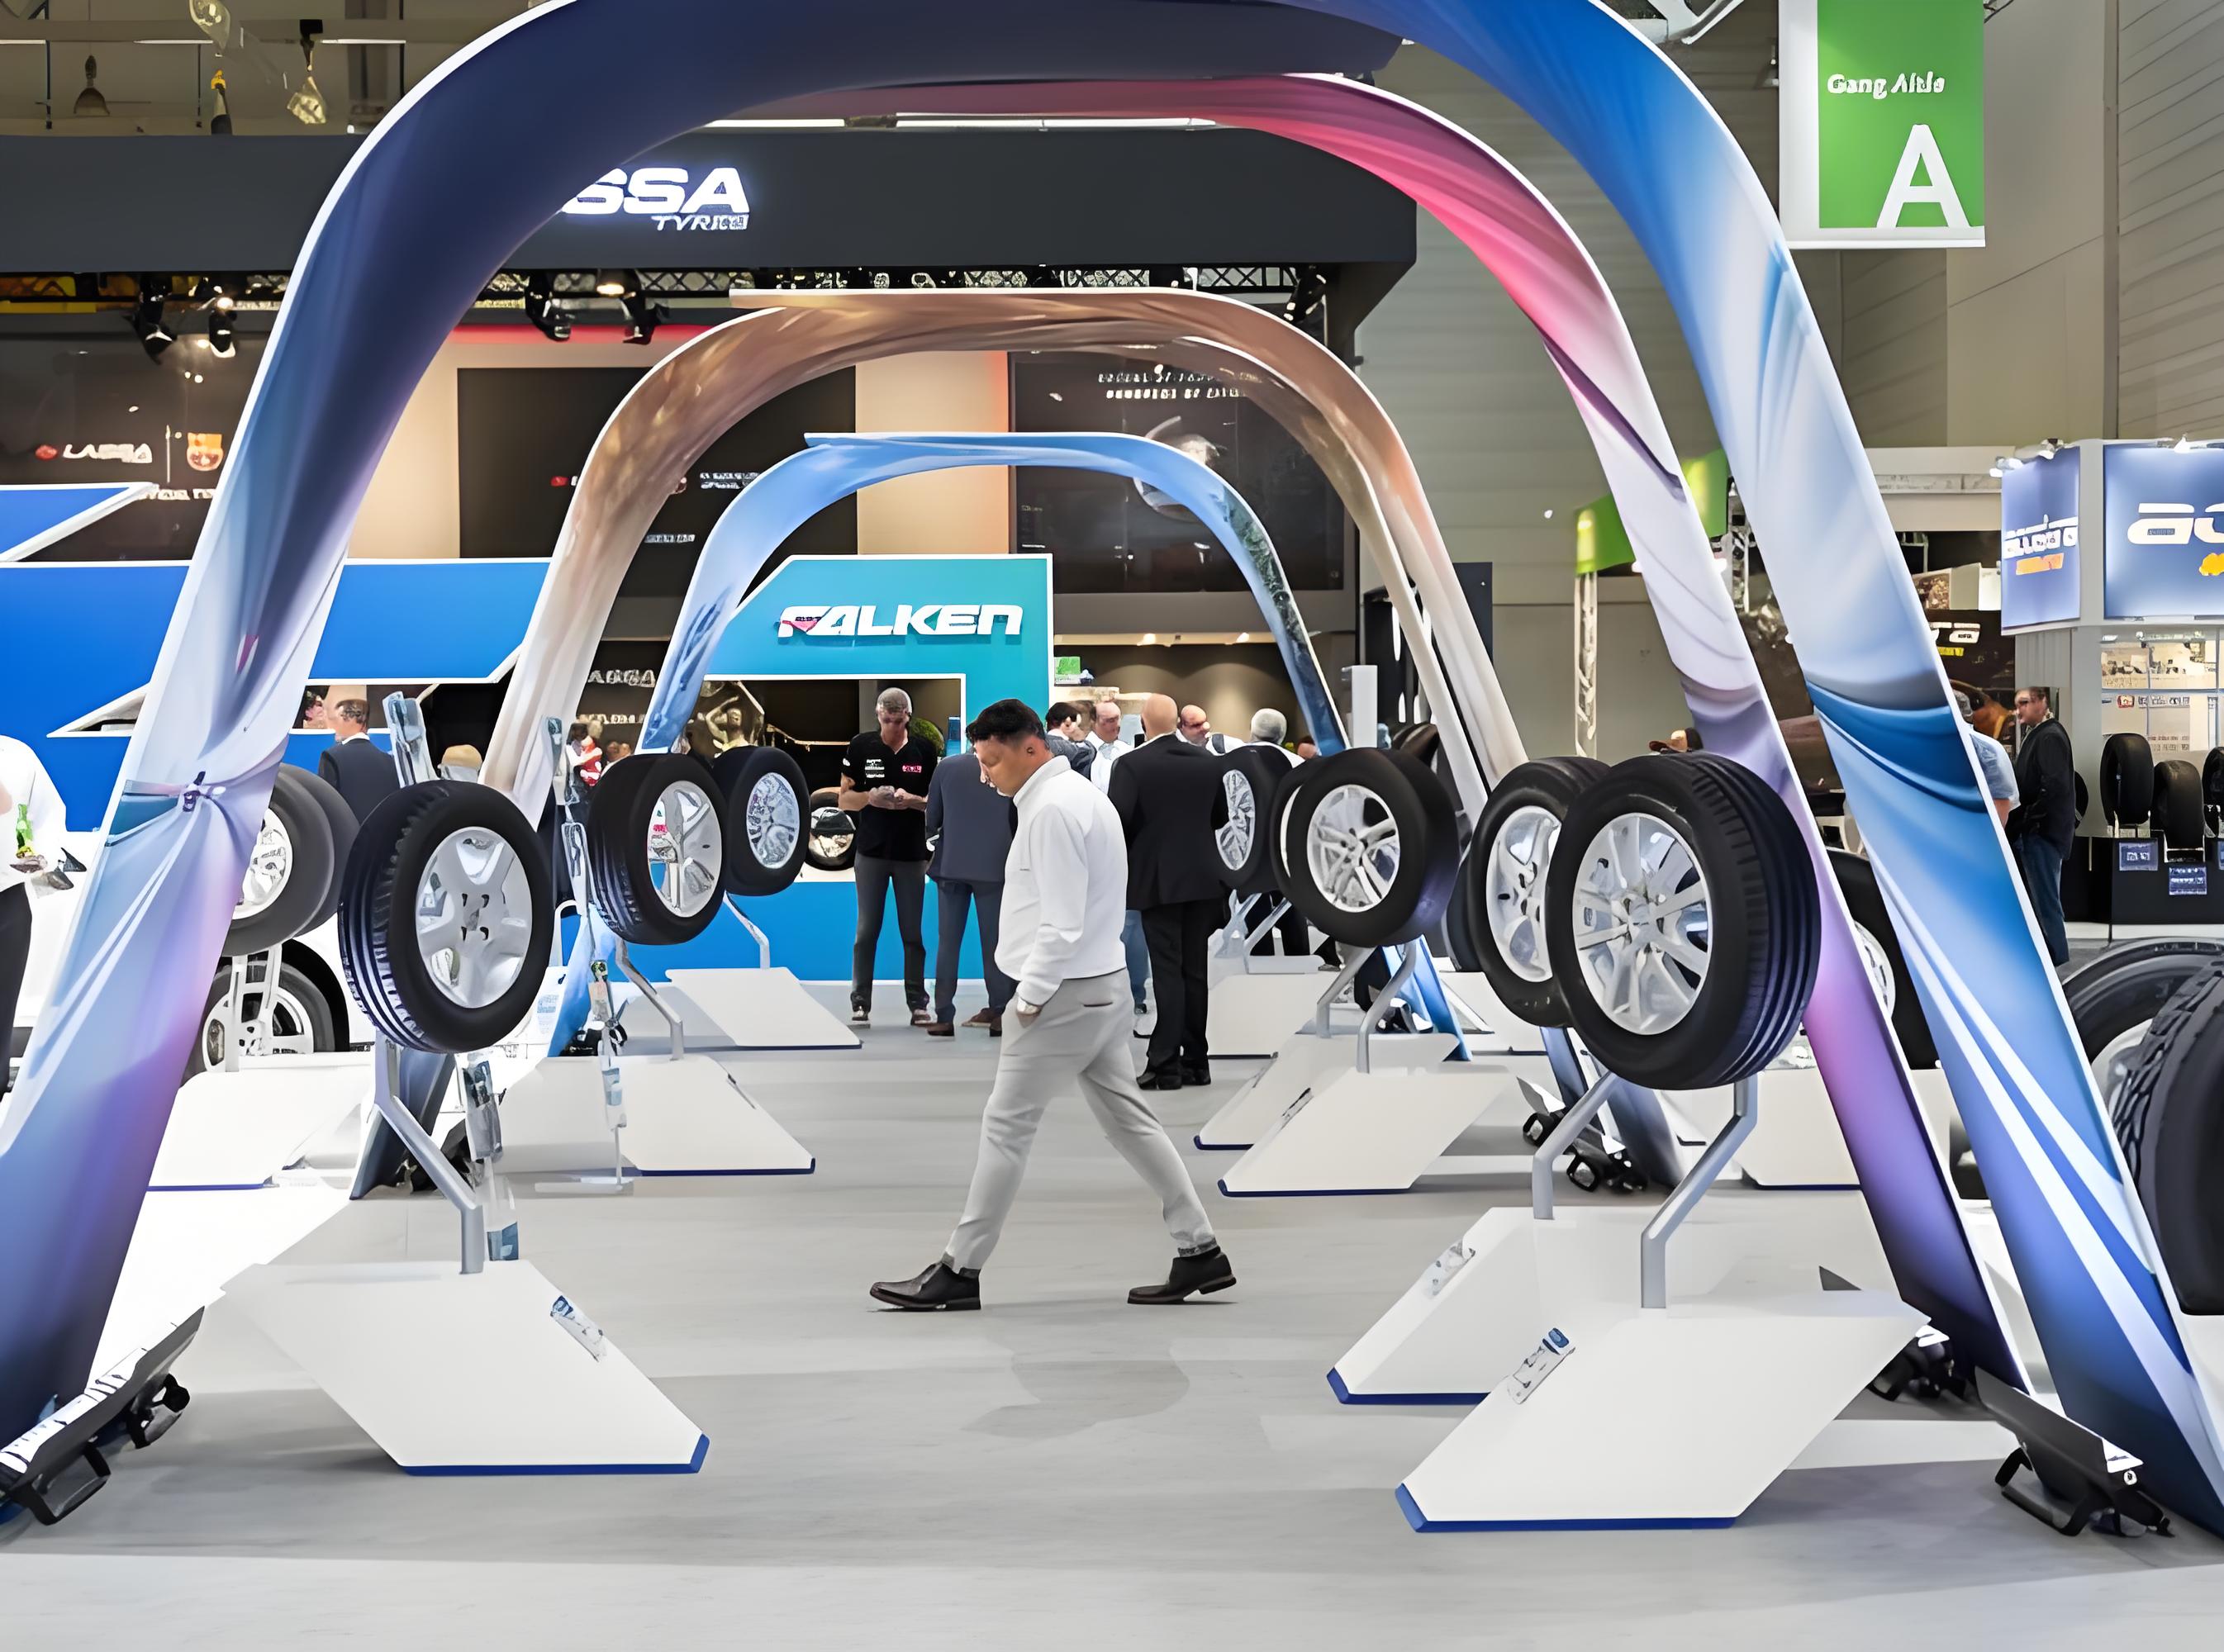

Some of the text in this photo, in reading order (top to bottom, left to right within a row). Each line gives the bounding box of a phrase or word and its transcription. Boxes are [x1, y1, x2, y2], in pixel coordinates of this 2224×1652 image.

[1827, 74, 1888, 100] Gang
[1876, 124, 1970, 228] A
[777, 605, 1024, 638] FALKEN
